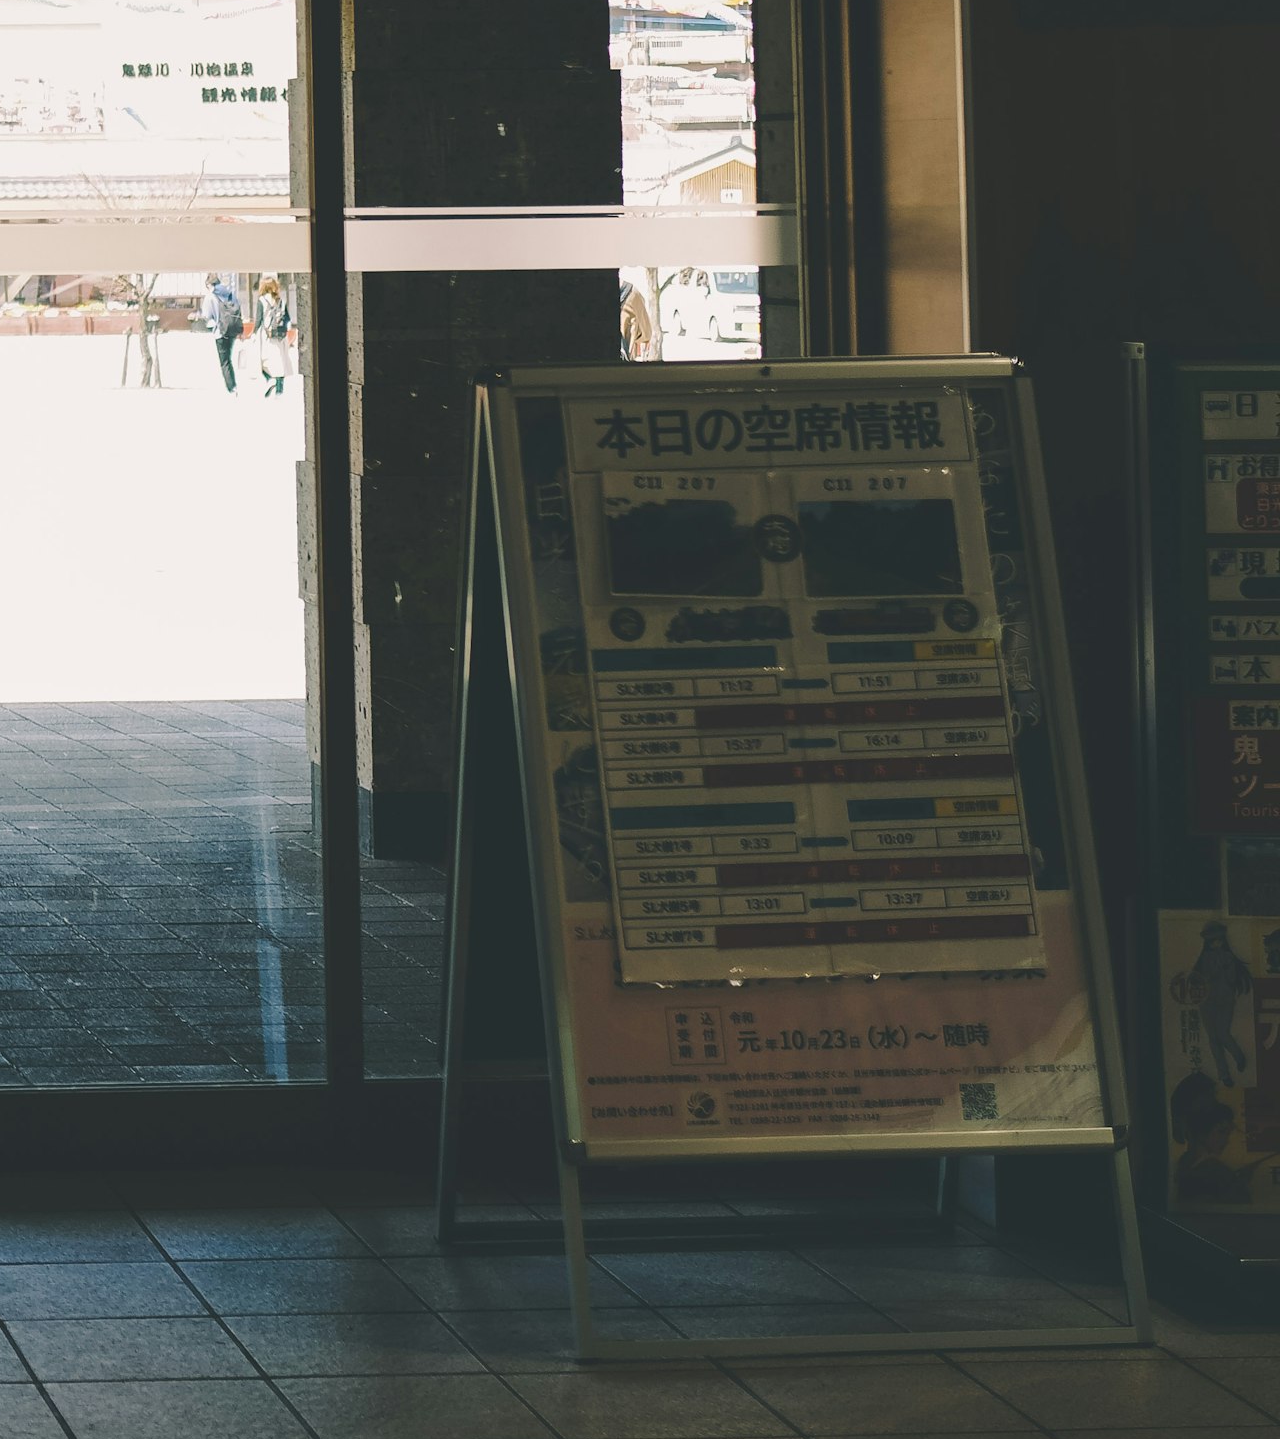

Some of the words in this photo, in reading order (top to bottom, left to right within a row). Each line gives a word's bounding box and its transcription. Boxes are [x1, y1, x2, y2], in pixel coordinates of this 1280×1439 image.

[594, 401, 945, 457] 本日の空席情報
[677, 477, 717, 491] 207
[867, 476, 908, 490] 207
[720, 679, 754, 693] 11:12
[858, 674, 892, 688] 11:51
[865, 732, 902, 747] 16:14
[741, 835, 770, 850] 9:33
[876, 832, 913, 846] 10:09
[744, 897, 780, 911] 13:01
[885, 892, 923, 906] 13:37
